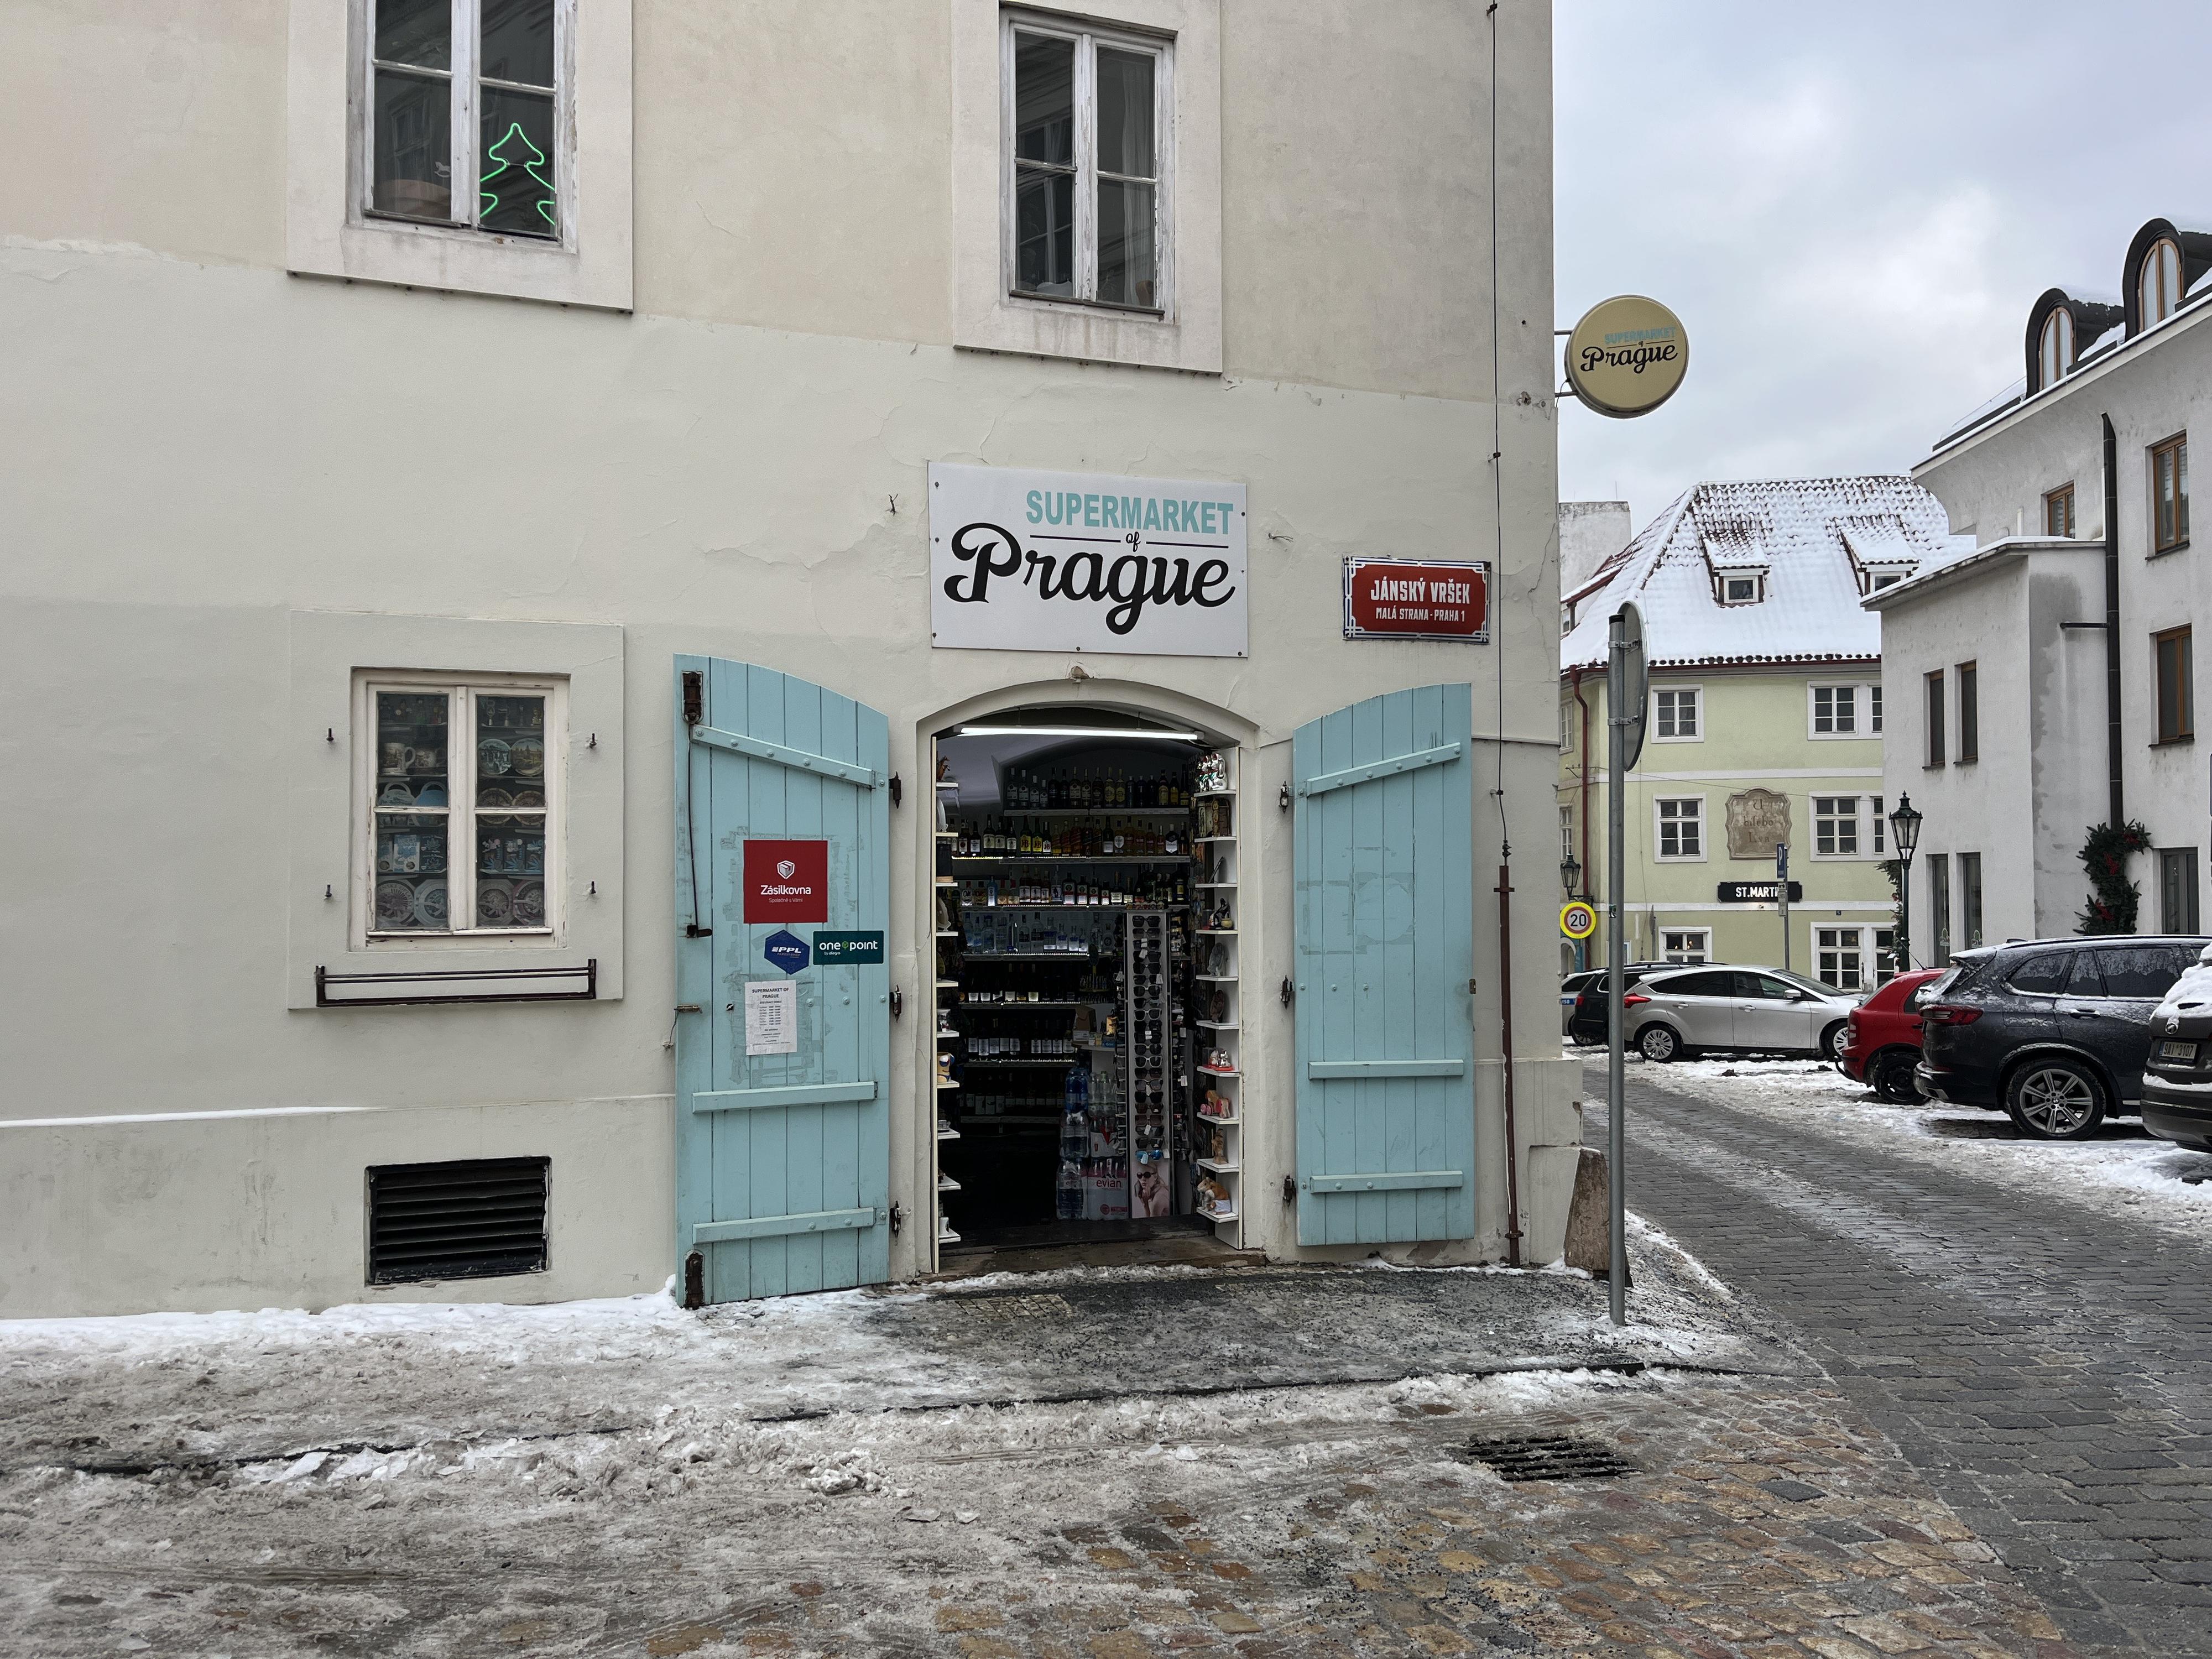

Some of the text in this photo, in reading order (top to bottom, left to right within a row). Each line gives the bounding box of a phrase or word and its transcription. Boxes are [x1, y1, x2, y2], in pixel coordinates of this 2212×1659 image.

[1605, 327, 1676, 345] SUPERMARKET
[1580, 345, 1678, 374] Prague
[1026, 489, 1234, 535] SUPERMARKET
[1125, 531, 1141, 552] of
[943, 522, 1235, 635] Prague
[1370, 576, 1470, 604] JÁNSKÝ VRŠEK
[1376, 605, 1396, 619] MALÁ
[1399, 608, 1429, 621] STRANA
[1434, 609, 1459, 622] PRAHA
[1460, 611, 1465, 622] 1
[1778, 846, 1783, 865] P
[760, 885, 811, 895] Zásilkovna
[1735, 886, 1779, 898] ST.MARTI
[1570, 914, 1587, 927] 20
[819, 940, 878, 951] one point
[1096, 1180, 1121, 1188] evian
